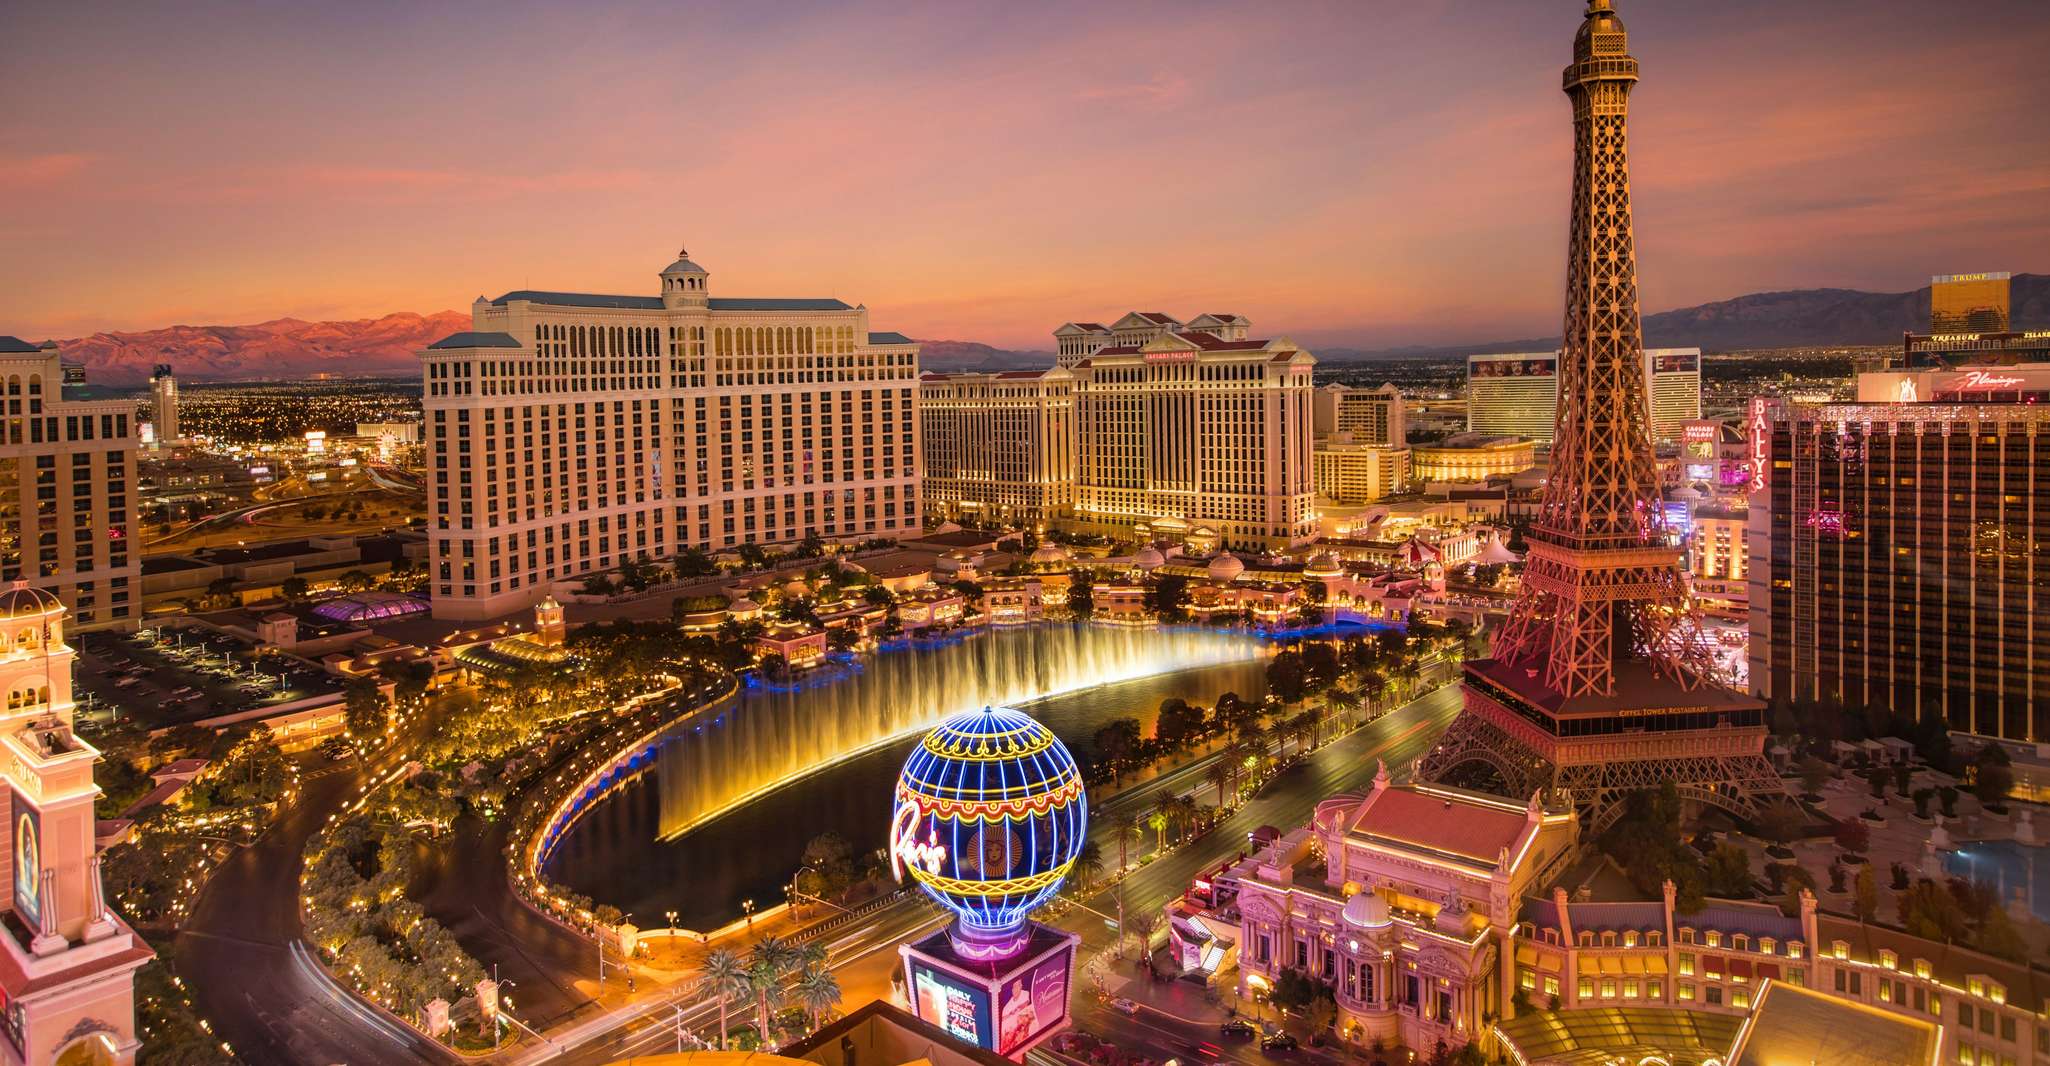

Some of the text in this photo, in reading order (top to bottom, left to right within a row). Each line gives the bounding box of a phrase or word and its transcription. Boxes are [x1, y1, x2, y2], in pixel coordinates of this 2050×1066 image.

[1953, 274, 1985, 282] TRUMP
[1932, 334, 1980, 342] TREASURE
[1966, 371, 2024, 388] Flamingo
[1643, 708, 1665, 716] TOWER
[1669, 706, 1708, 714] RESTAURANT
[890, 800, 947, 884] Paris
[947, 986, 971, 1001] DAILY
